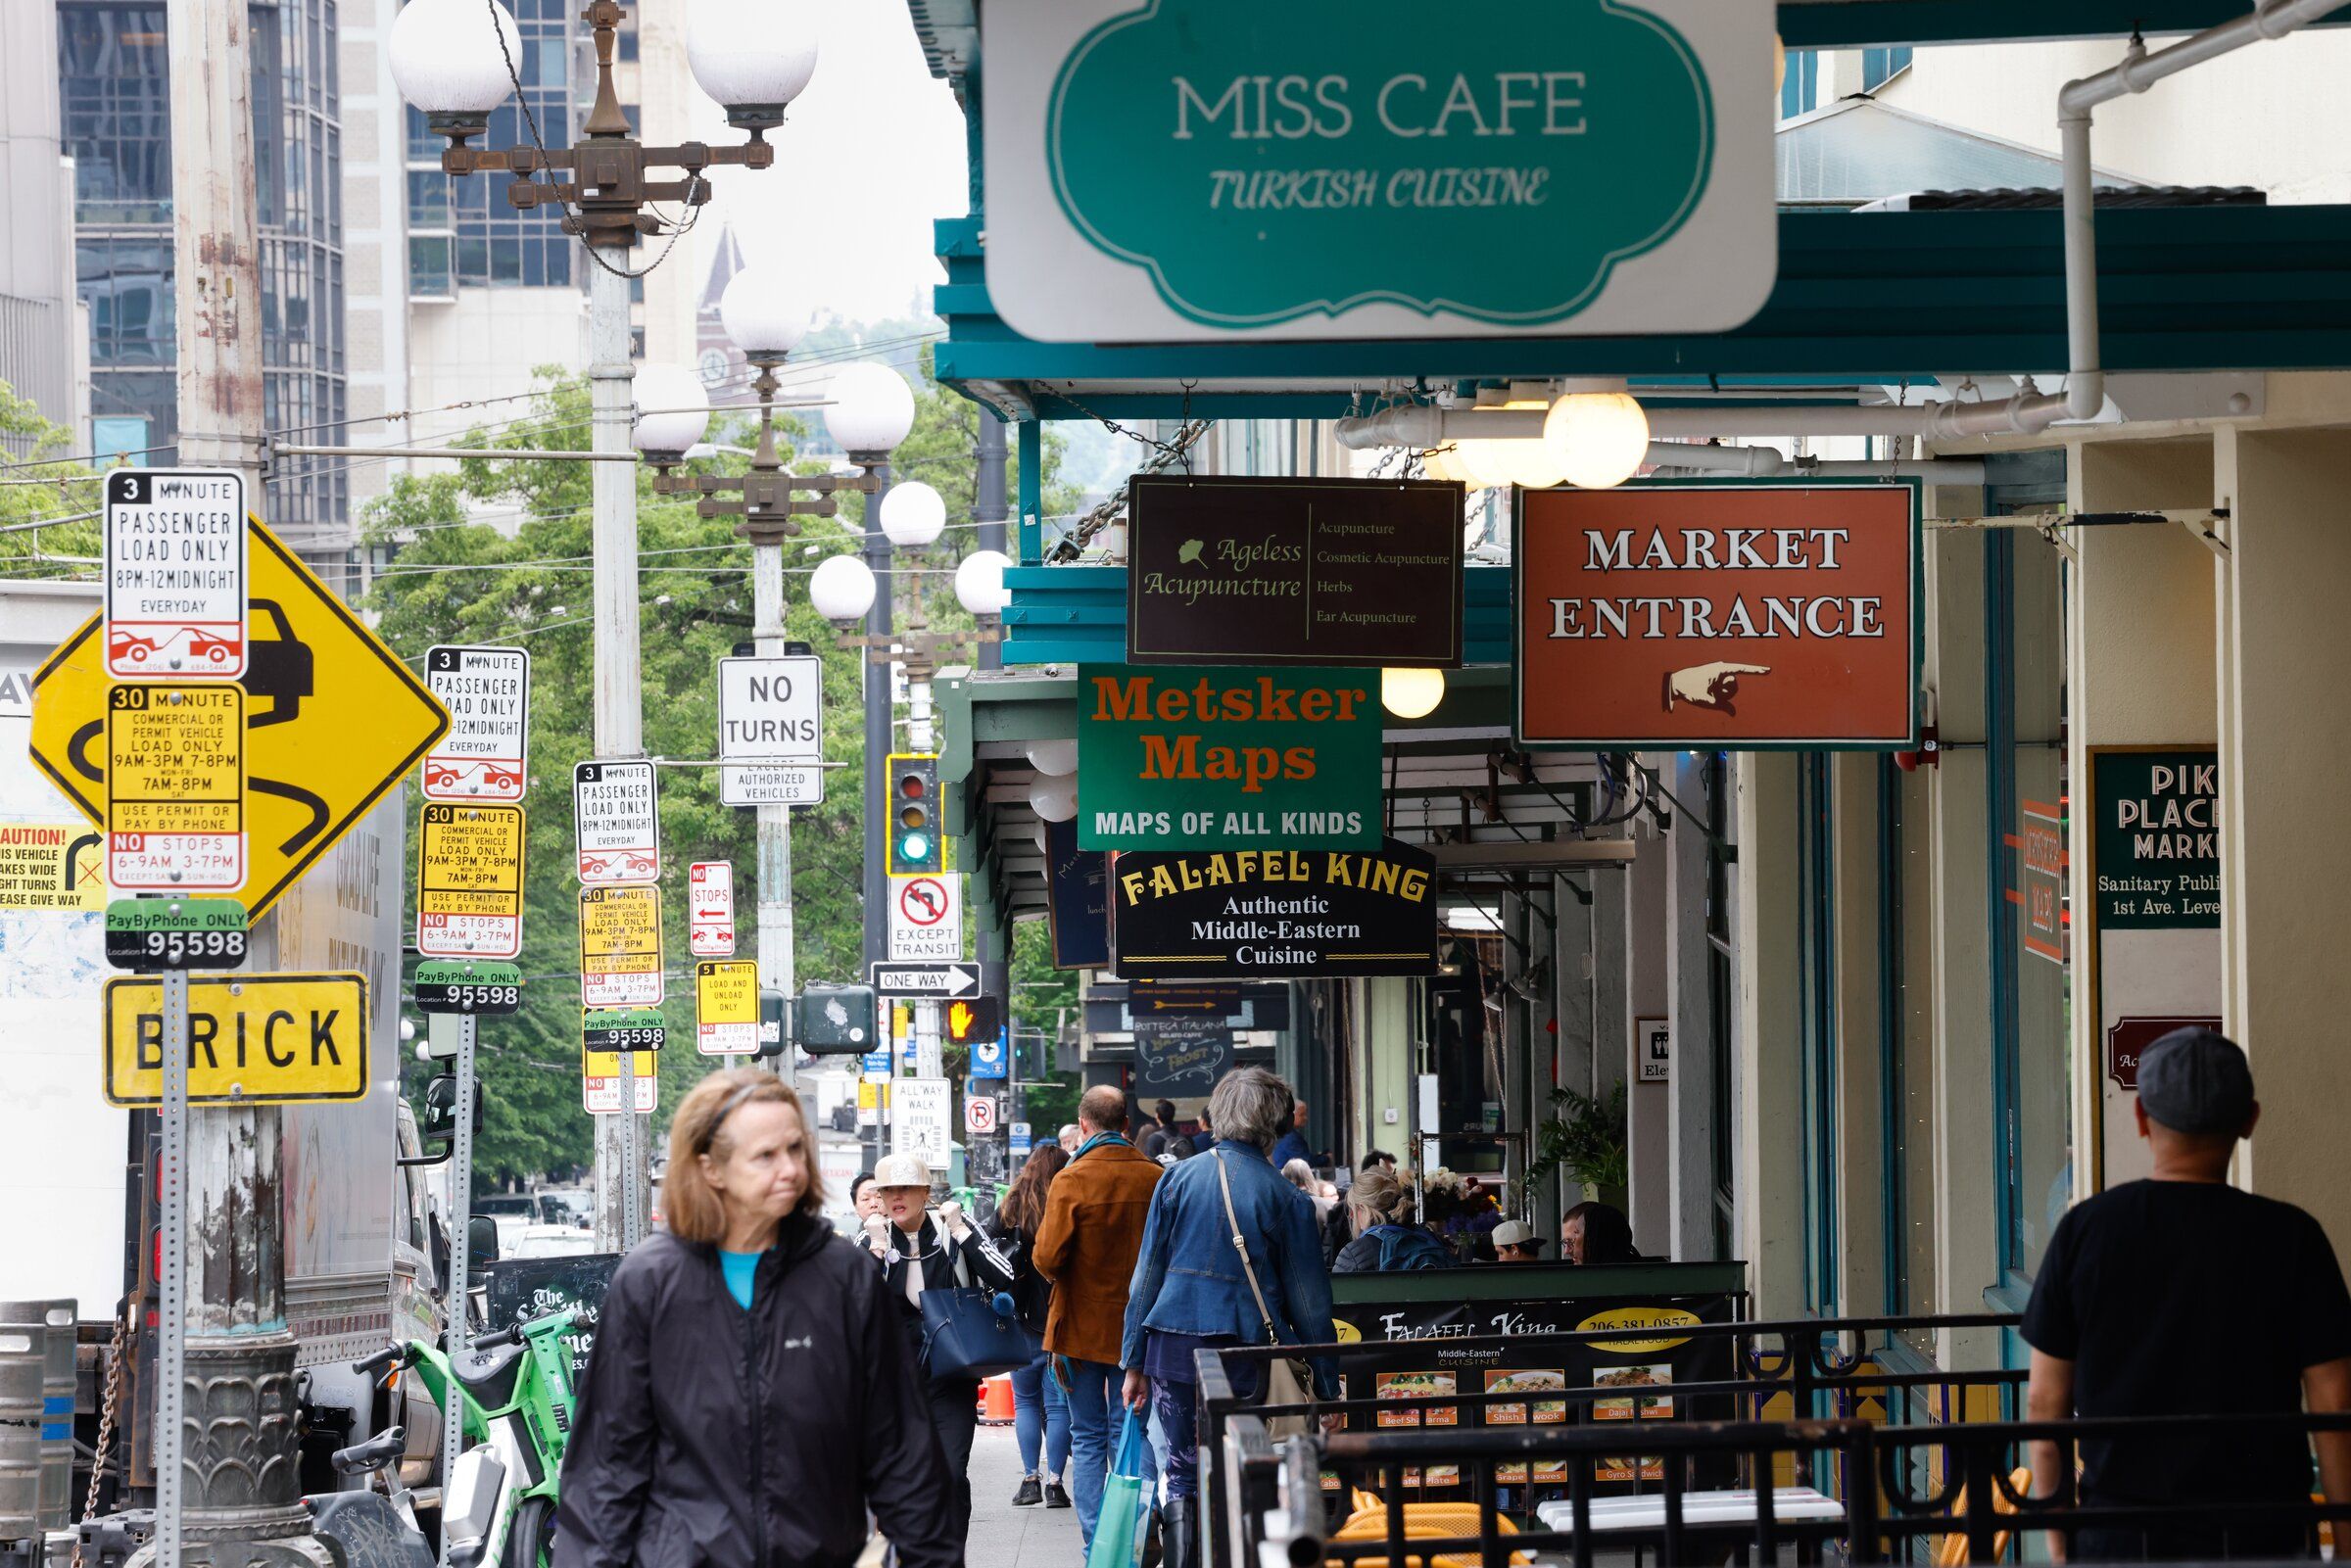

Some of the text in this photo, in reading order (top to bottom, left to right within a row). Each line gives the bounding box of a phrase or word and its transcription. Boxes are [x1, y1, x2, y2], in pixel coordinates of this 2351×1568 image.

[1173, 72, 1587, 139] MISS CAFE
[1210, 167, 1550, 209] TURKISH CUISINE
[122, 478, 139, 499] 3
[120, 512, 230, 534] PASSENGER
[1319, 522, 1395, 536] Acupuncture
[121, 540, 228, 561] LOAD ONLY
[1217, 534, 1301, 573] Ageless
[1582, 523, 1849, 574] MARKET
[1317, 551, 1450, 566] Cosmetic Acupuncture
[117, 570, 234, 589] 8PM-12MIDNIGHT
[1317, 580, 1353, 593] Herbs
[1145, 572, 1301, 606] Acupuncture
[141, 600, 207, 612] EVERYDAY
[1317, 610, 1416, 625] Ear Acupuncture
[1548, 592, 1885, 640] ENTRANCE
[440, 652, 451, 668] 3
[437, 678, 516, 695] PASSENGER
[750, 676, 792, 702] NO
[115, 689, 232, 708] 30 MNUTE
[1091, 676, 1367, 722] Metsker
[482, 698, 515, 715] ONLY
[133, 714, 223, 724] COMMERCIAL OR
[133, 728, 223, 737] PERMIT VEHICLE
[726, 720, 815, 742] TURNS
[131, 741, 222, 751] LOAD ONLY
[450, 742, 498, 752] EVERYDAY
[115, 755, 236, 767] 9AM-3PM 7-8PM
[1139, 735, 1317, 793] Maps
[739, 774, 805, 784] AUTHORIZED
[584, 785, 647, 799] PASSENGER
[745, 788, 799, 798] VEHICLES
[122, 806, 229, 816] USE PERMIT OR
[429, 808, 450, 822] 30
[586, 801, 647, 815] LOAD ONLY
[125, 820, 225, 830] PAY BY PHONE
[583, 818, 650, 832] 8PM-12MIDNIGHT
[1095, 812, 1362, 835] MAPS OF ALL KINDS
[442, 827, 493, 835] COMMERCIAL
[115, 833, 223, 850] NO STOPS
[598, 836, 635, 845] EVERYDAY
[2135, 834, 2220, 859] MARK
[16, 849, 58, 860] VEHICLE
[427, 856, 515, 867] 9AM-3PM 7-8PM
[119, 856, 233, 868] 6-9AM 3-7PM
[29, 865, 56, 875] WIDE
[694, 869, 704, 880] NO
[22, 879, 56, 890] TURNS
[1121, 851, 1429, 907] FALAFEL KING
[2098, 876, 2172, 895] Sanitary
[30, 895, 53, 905] GIVE
[58, 895, 81, 905] WAY
[695, 889, 728, 902] STOPS
[1223, 896, 1329, 916] Authentic
[2113, 900, 2135, 915] 1st
[2142, 899, 2175, 914] Ave.
[108, 914, 244, 928] PayByPhone ONLY
[425, 915, 504, 928] NO STOPS
[428, 930, 510, 941] 6-9AM 3-7PM
[897, 929, 954, 940] EXCEPT
[1191, 921, 1361, 940] Middle-Eastern
[148, 931, 244, 956] 95598
[894, 943, 957, 954] TRANSIT
[1235, 945, 1318, 966] Cuisine
[418, 972, 518, 983] PayByPhone ONLY
[885, 974, 947, 987] ONE WAY
[448, 985, 517, 1004] 95598
[137, 1010, 341, 1069] BRICK
[609, 1028, 663, 1044] 95598
[1645, 1065, 1668, 1075] Ele
[900, 1085, 943, 1095] ALL WAY
[908, 1100, 935, 1109] WALK
[533, 1288, 564, 1307] The
[1609, 1408, 1629, 1417] Dajaj
